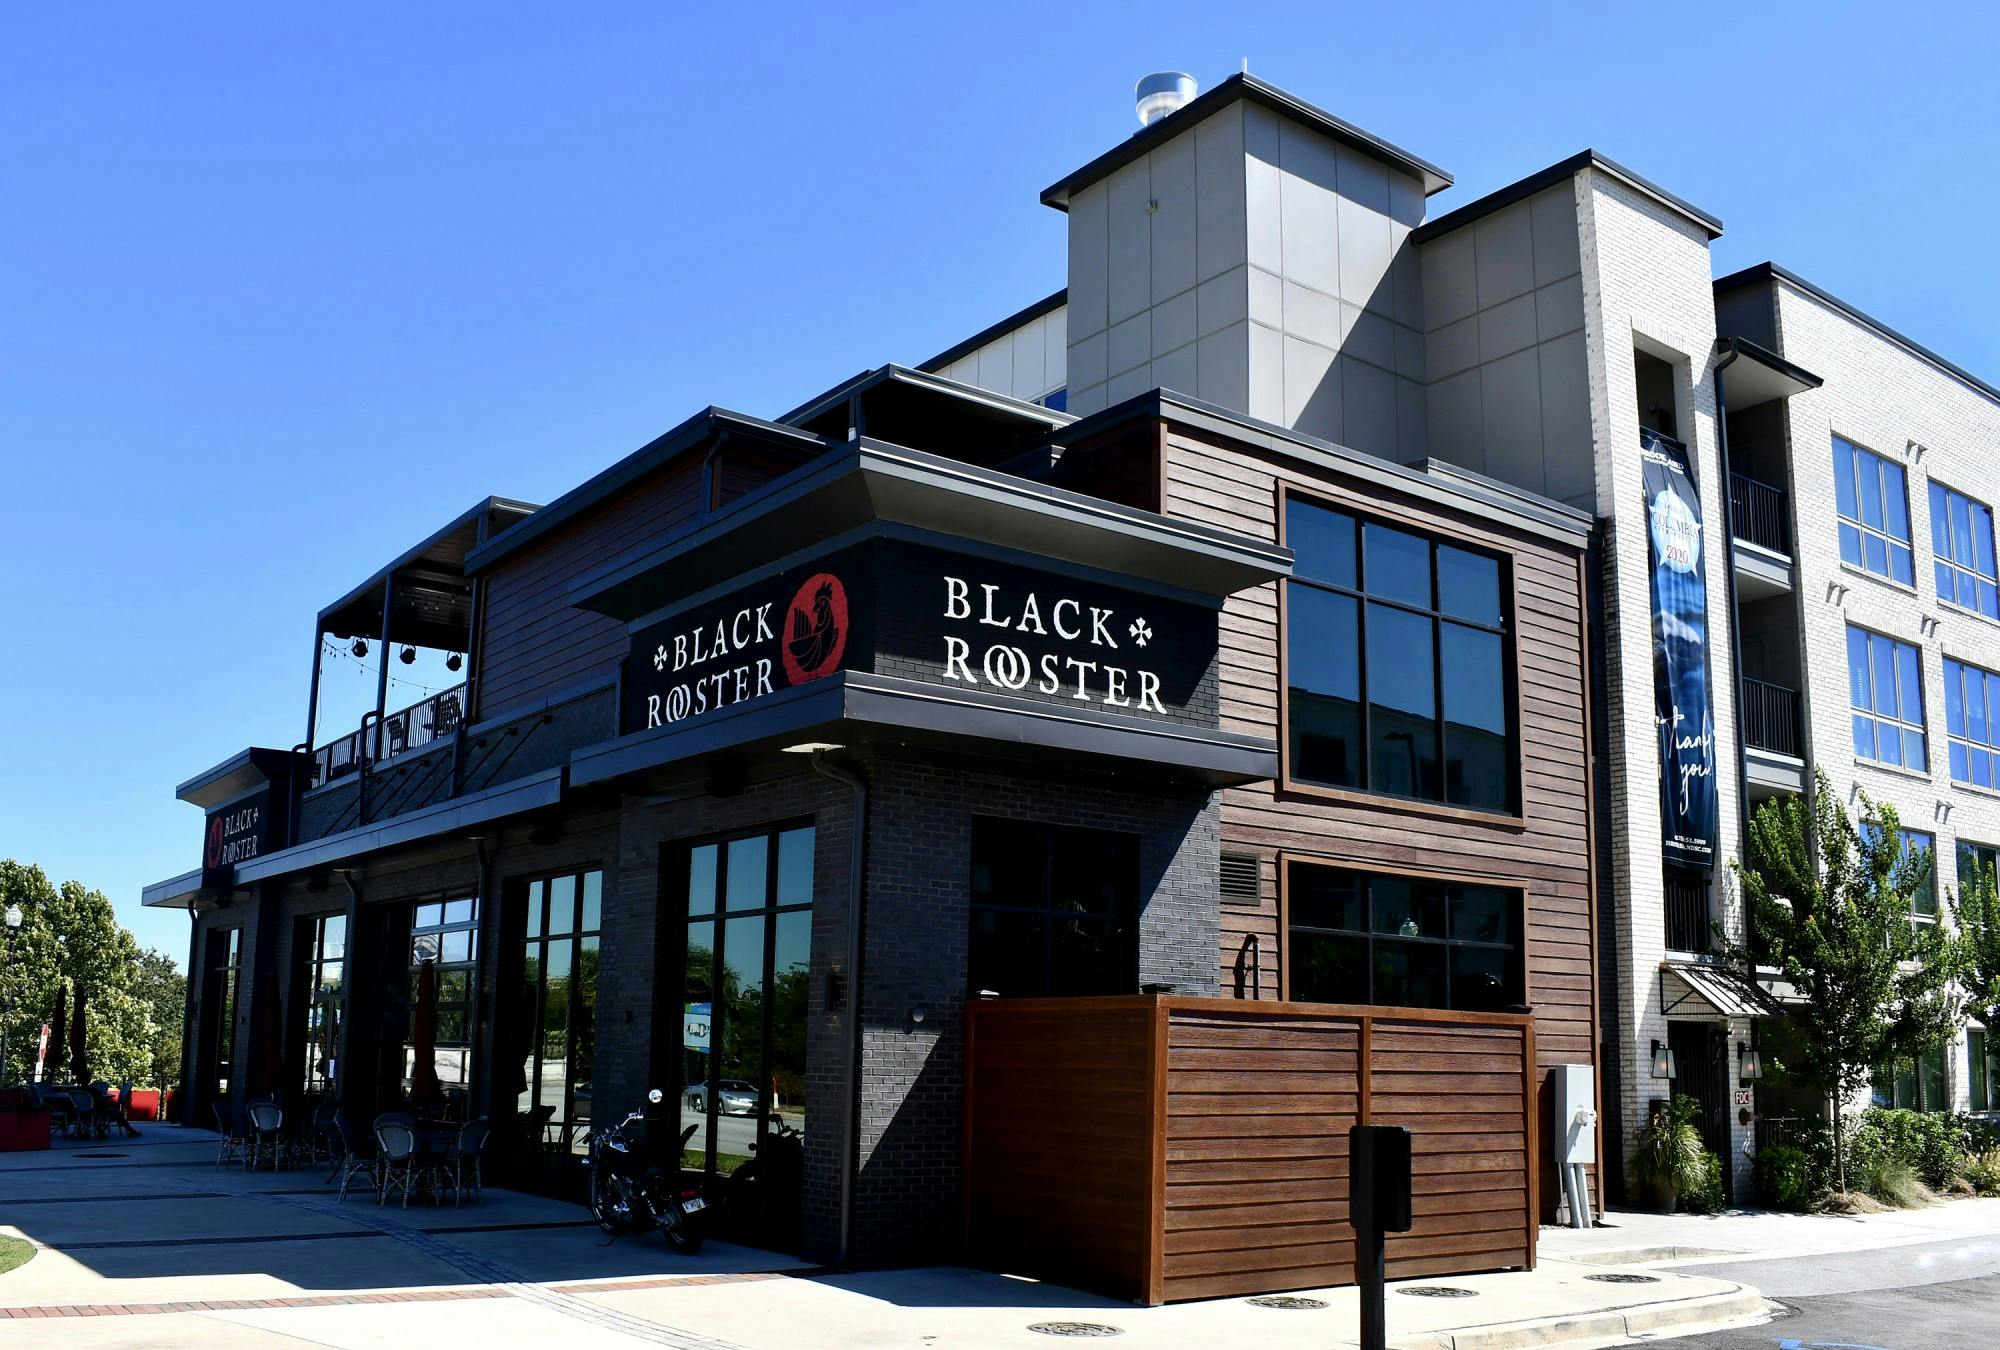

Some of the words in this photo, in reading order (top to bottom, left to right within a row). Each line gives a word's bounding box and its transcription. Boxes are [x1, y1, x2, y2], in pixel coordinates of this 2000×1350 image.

[1666, 544, 1689, 565] 2020
[672, 602, 774, 672] BLACK
[943, 576, 1118, 649] BLACK
[647, 658, 774, 729] ROOSTER
[943, 635, 1168, 715] ROOSTER
[224, 808, 252, 837] BLACK
[222, 834, 257, 865] ROOSTER
[1735, 1091, 1749, 1104] FDC
